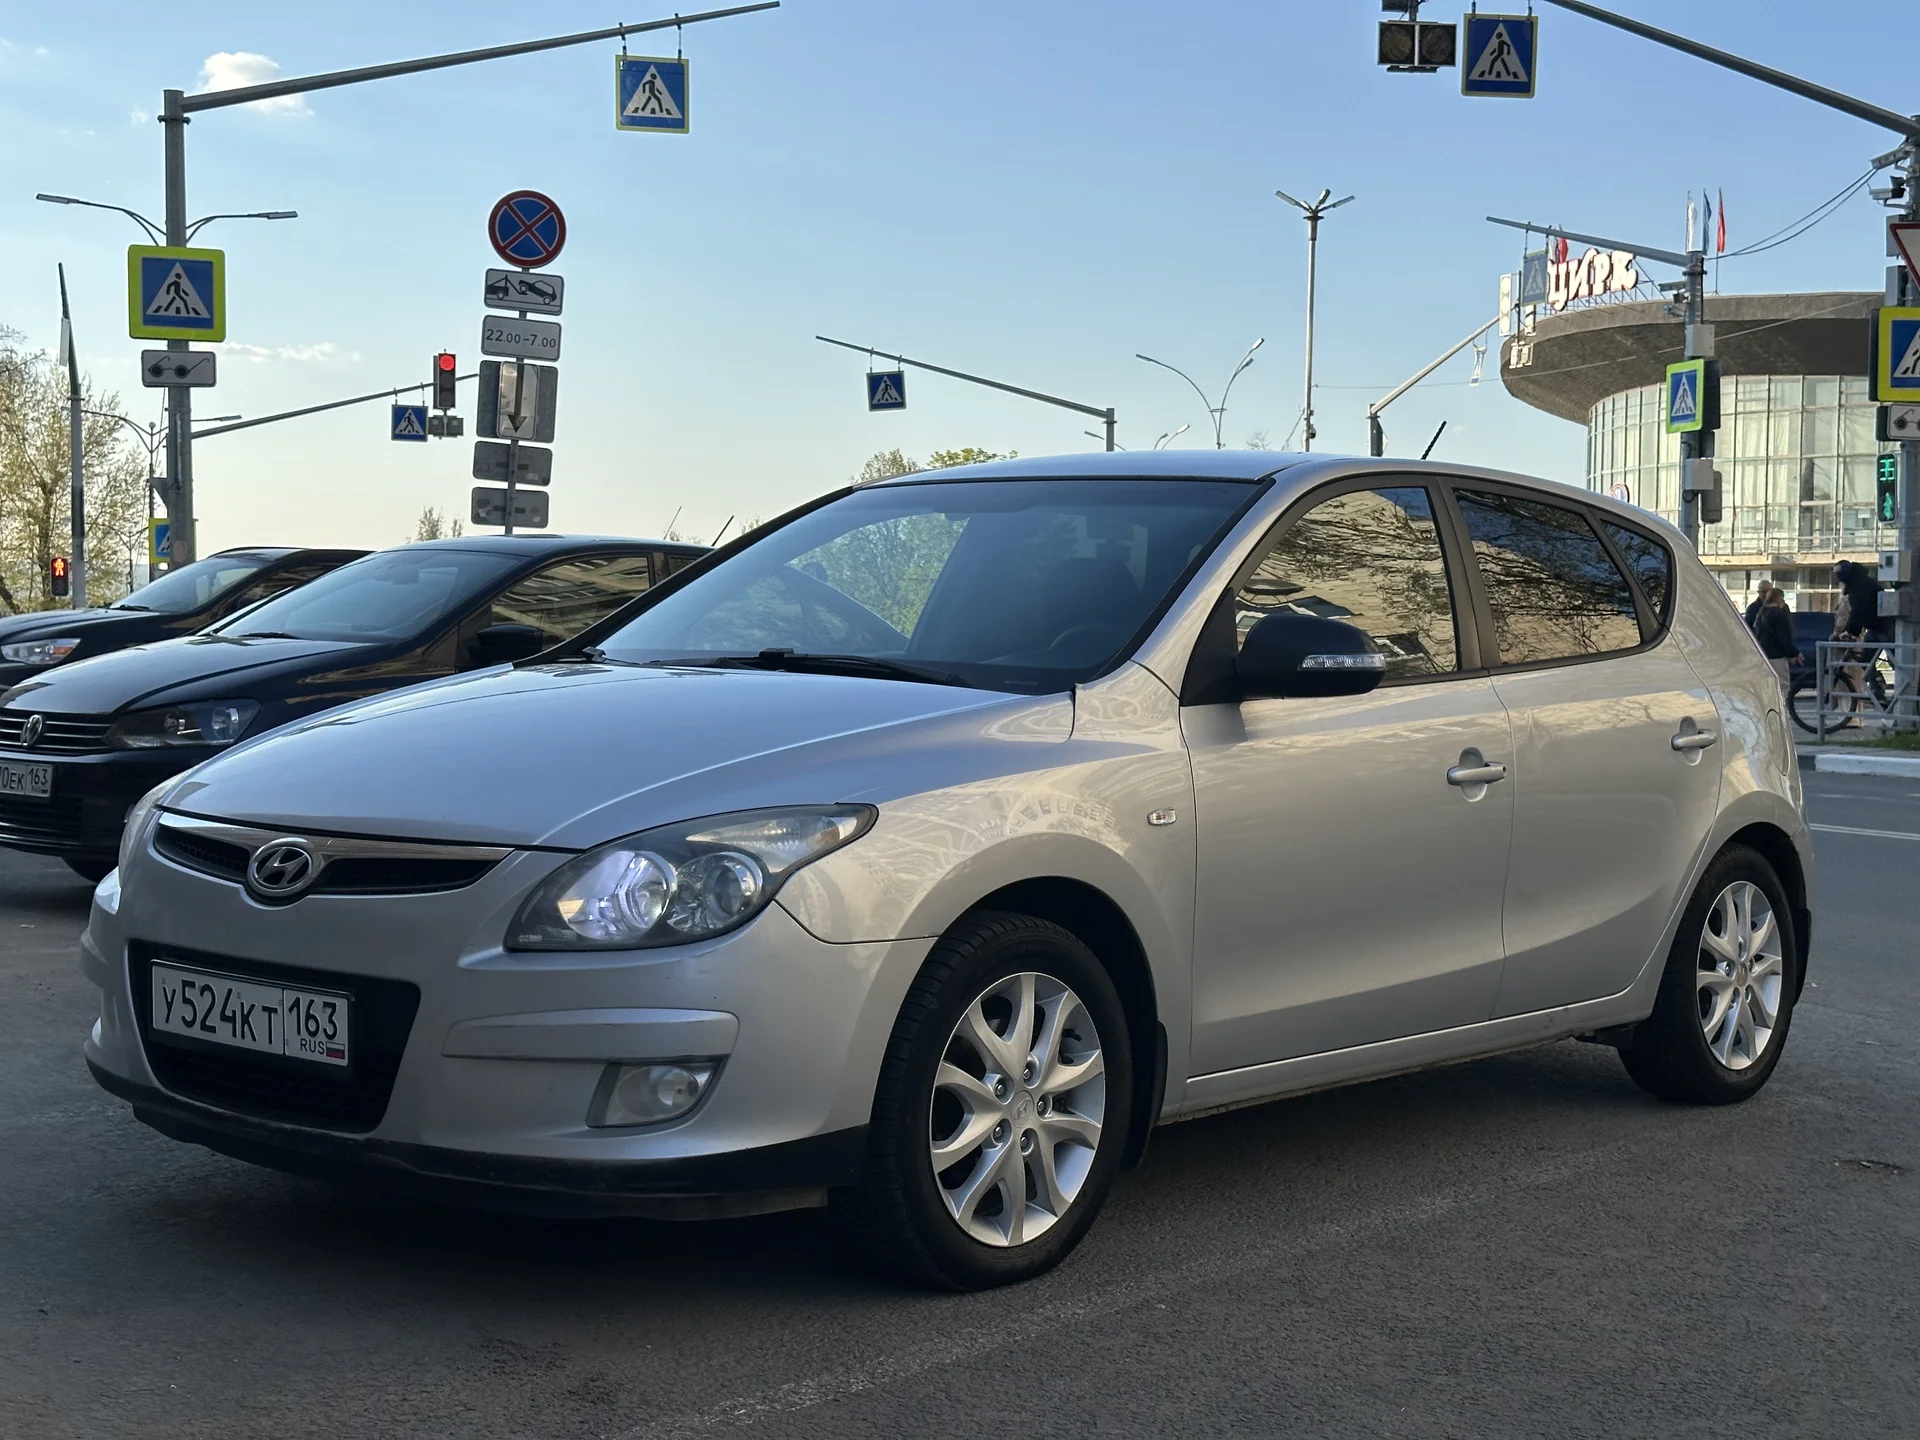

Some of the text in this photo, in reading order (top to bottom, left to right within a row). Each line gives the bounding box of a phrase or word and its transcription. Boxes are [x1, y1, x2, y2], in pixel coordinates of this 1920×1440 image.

[1548, 247, 1638, 311] ЦИРК
[485, 328, 557, 349] 22.00-7.00
[28, 767, 48, 786] 163
[288, 997, 338, 1040] 163
[300, 1038, 325, 1055] RUS
